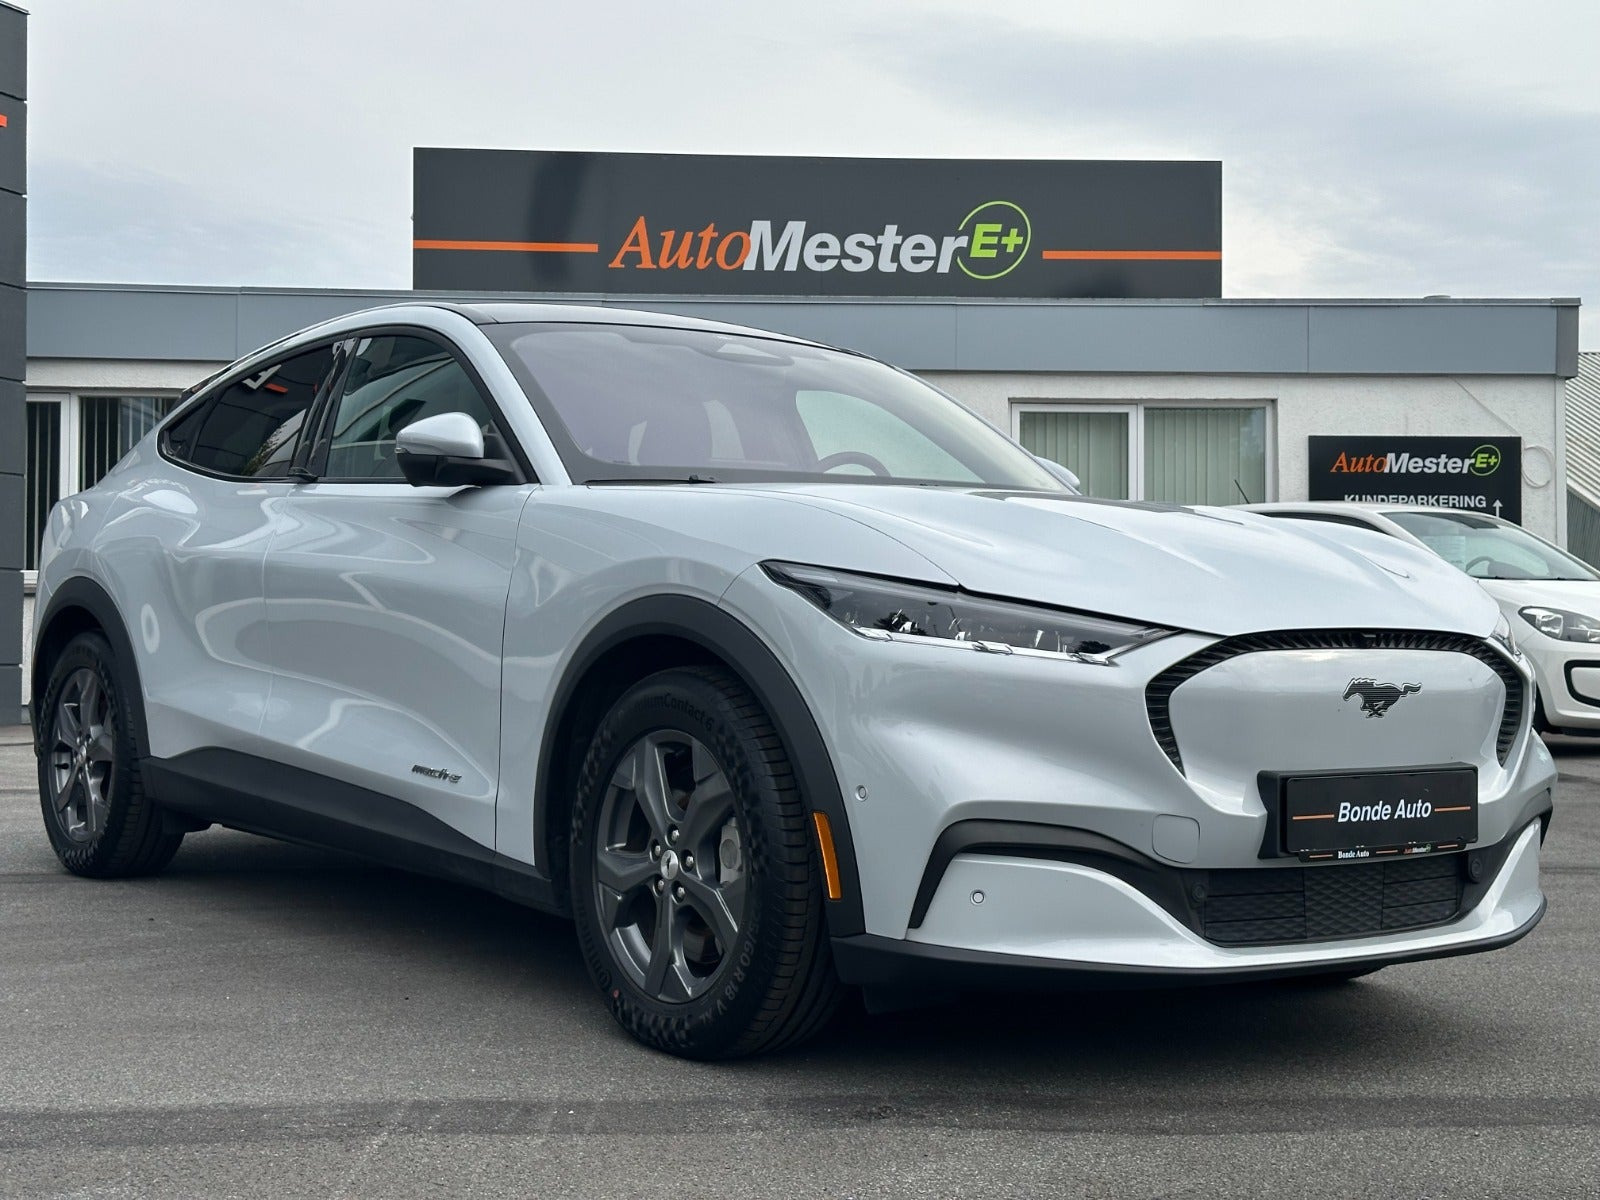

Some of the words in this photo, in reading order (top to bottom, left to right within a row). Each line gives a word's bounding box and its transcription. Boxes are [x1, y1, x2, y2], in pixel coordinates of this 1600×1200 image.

[1337, 800, 1391, 823] Bonde
[1394, 799, 1432, 819] Auto
[1337, 850, 1356, 859] Bonde
[1356, 850, 1370, 858] Auto
